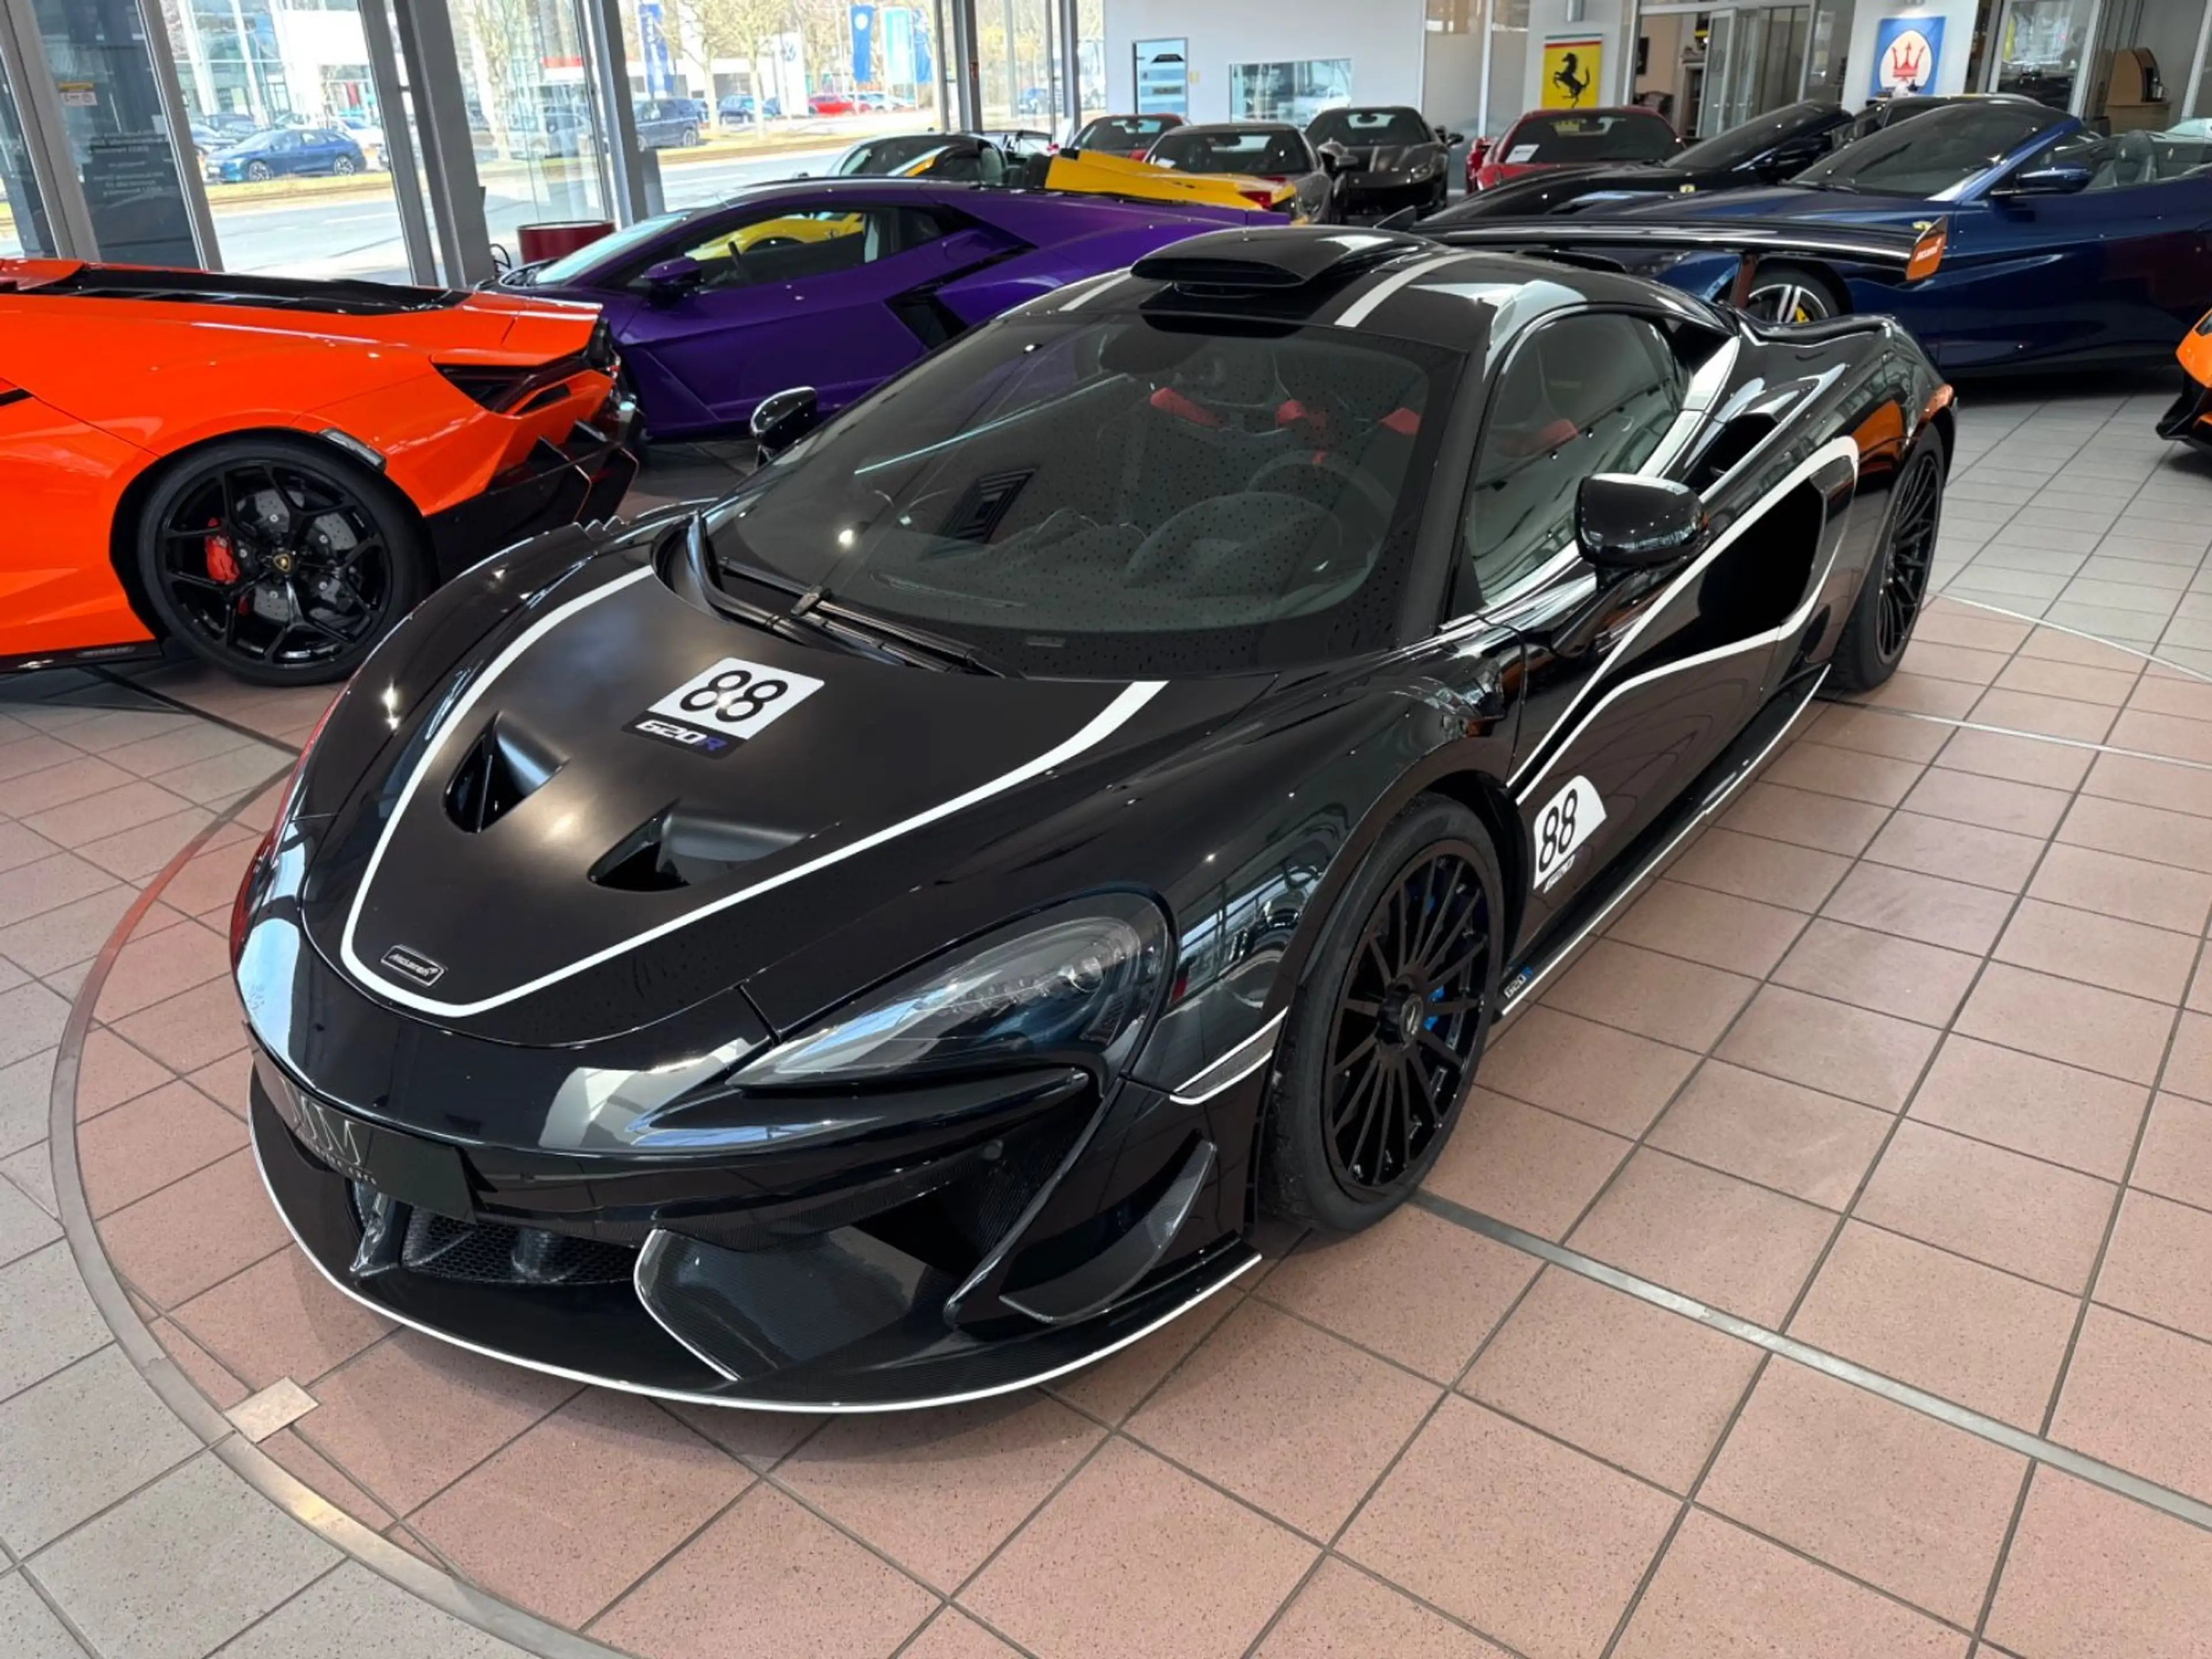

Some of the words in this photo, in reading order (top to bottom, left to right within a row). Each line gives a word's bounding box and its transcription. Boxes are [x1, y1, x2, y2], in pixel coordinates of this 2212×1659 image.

[680, 670, 789, 722] 88
[635, 719, 727, 751] 620R
[1539, 789, 1578, 873] 88
